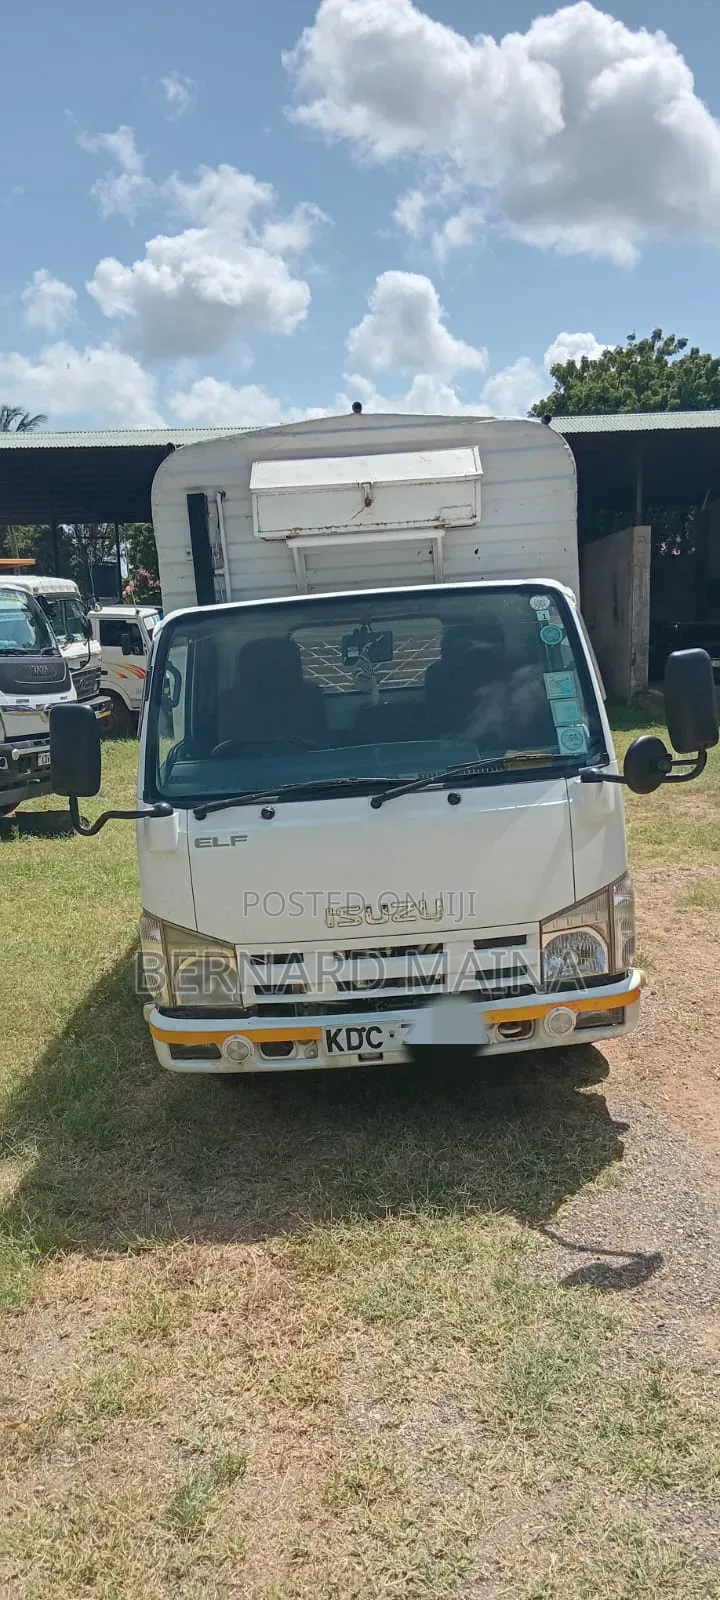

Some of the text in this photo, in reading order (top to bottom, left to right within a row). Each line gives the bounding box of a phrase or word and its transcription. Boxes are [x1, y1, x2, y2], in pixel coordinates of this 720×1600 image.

[194, 834, 248, 848] ELF
[325, 898, 444, 928] ISUZU
[325, 1026, 384, 1053] KDC
